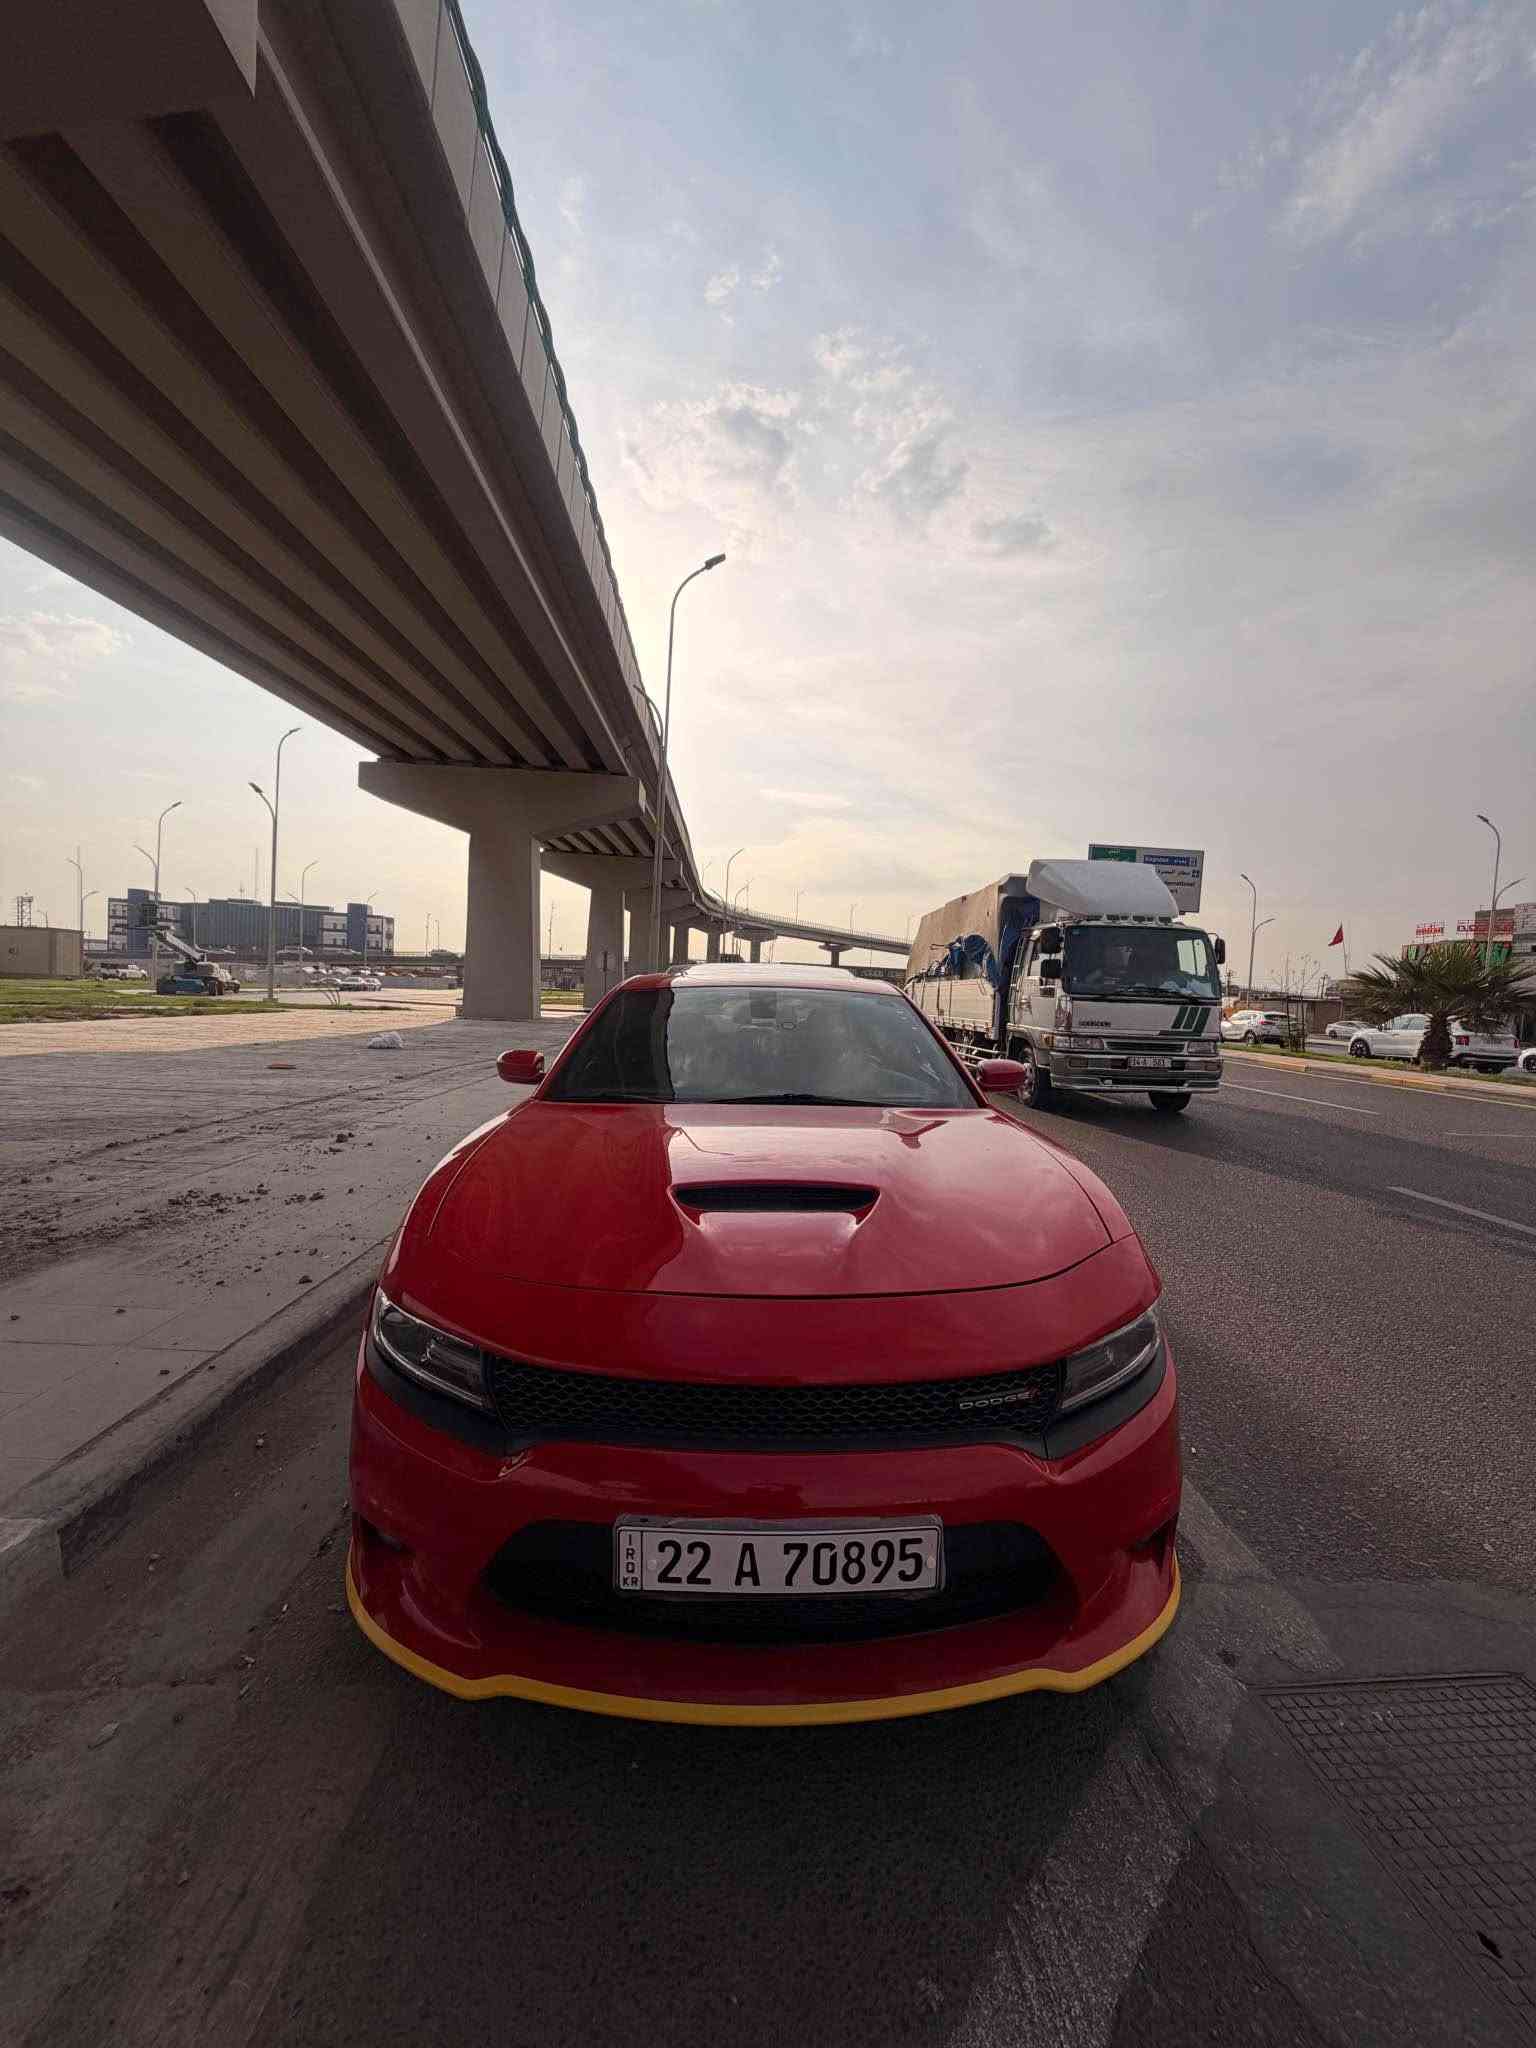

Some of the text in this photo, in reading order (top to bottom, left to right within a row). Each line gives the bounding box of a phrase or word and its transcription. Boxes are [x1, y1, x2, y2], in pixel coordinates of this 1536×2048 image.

[959, 1392, 1032, 1410] DODGE
[657, 1537, 924, 1587] 22 A 70895
[622, 1576, 638, 1587] KR
